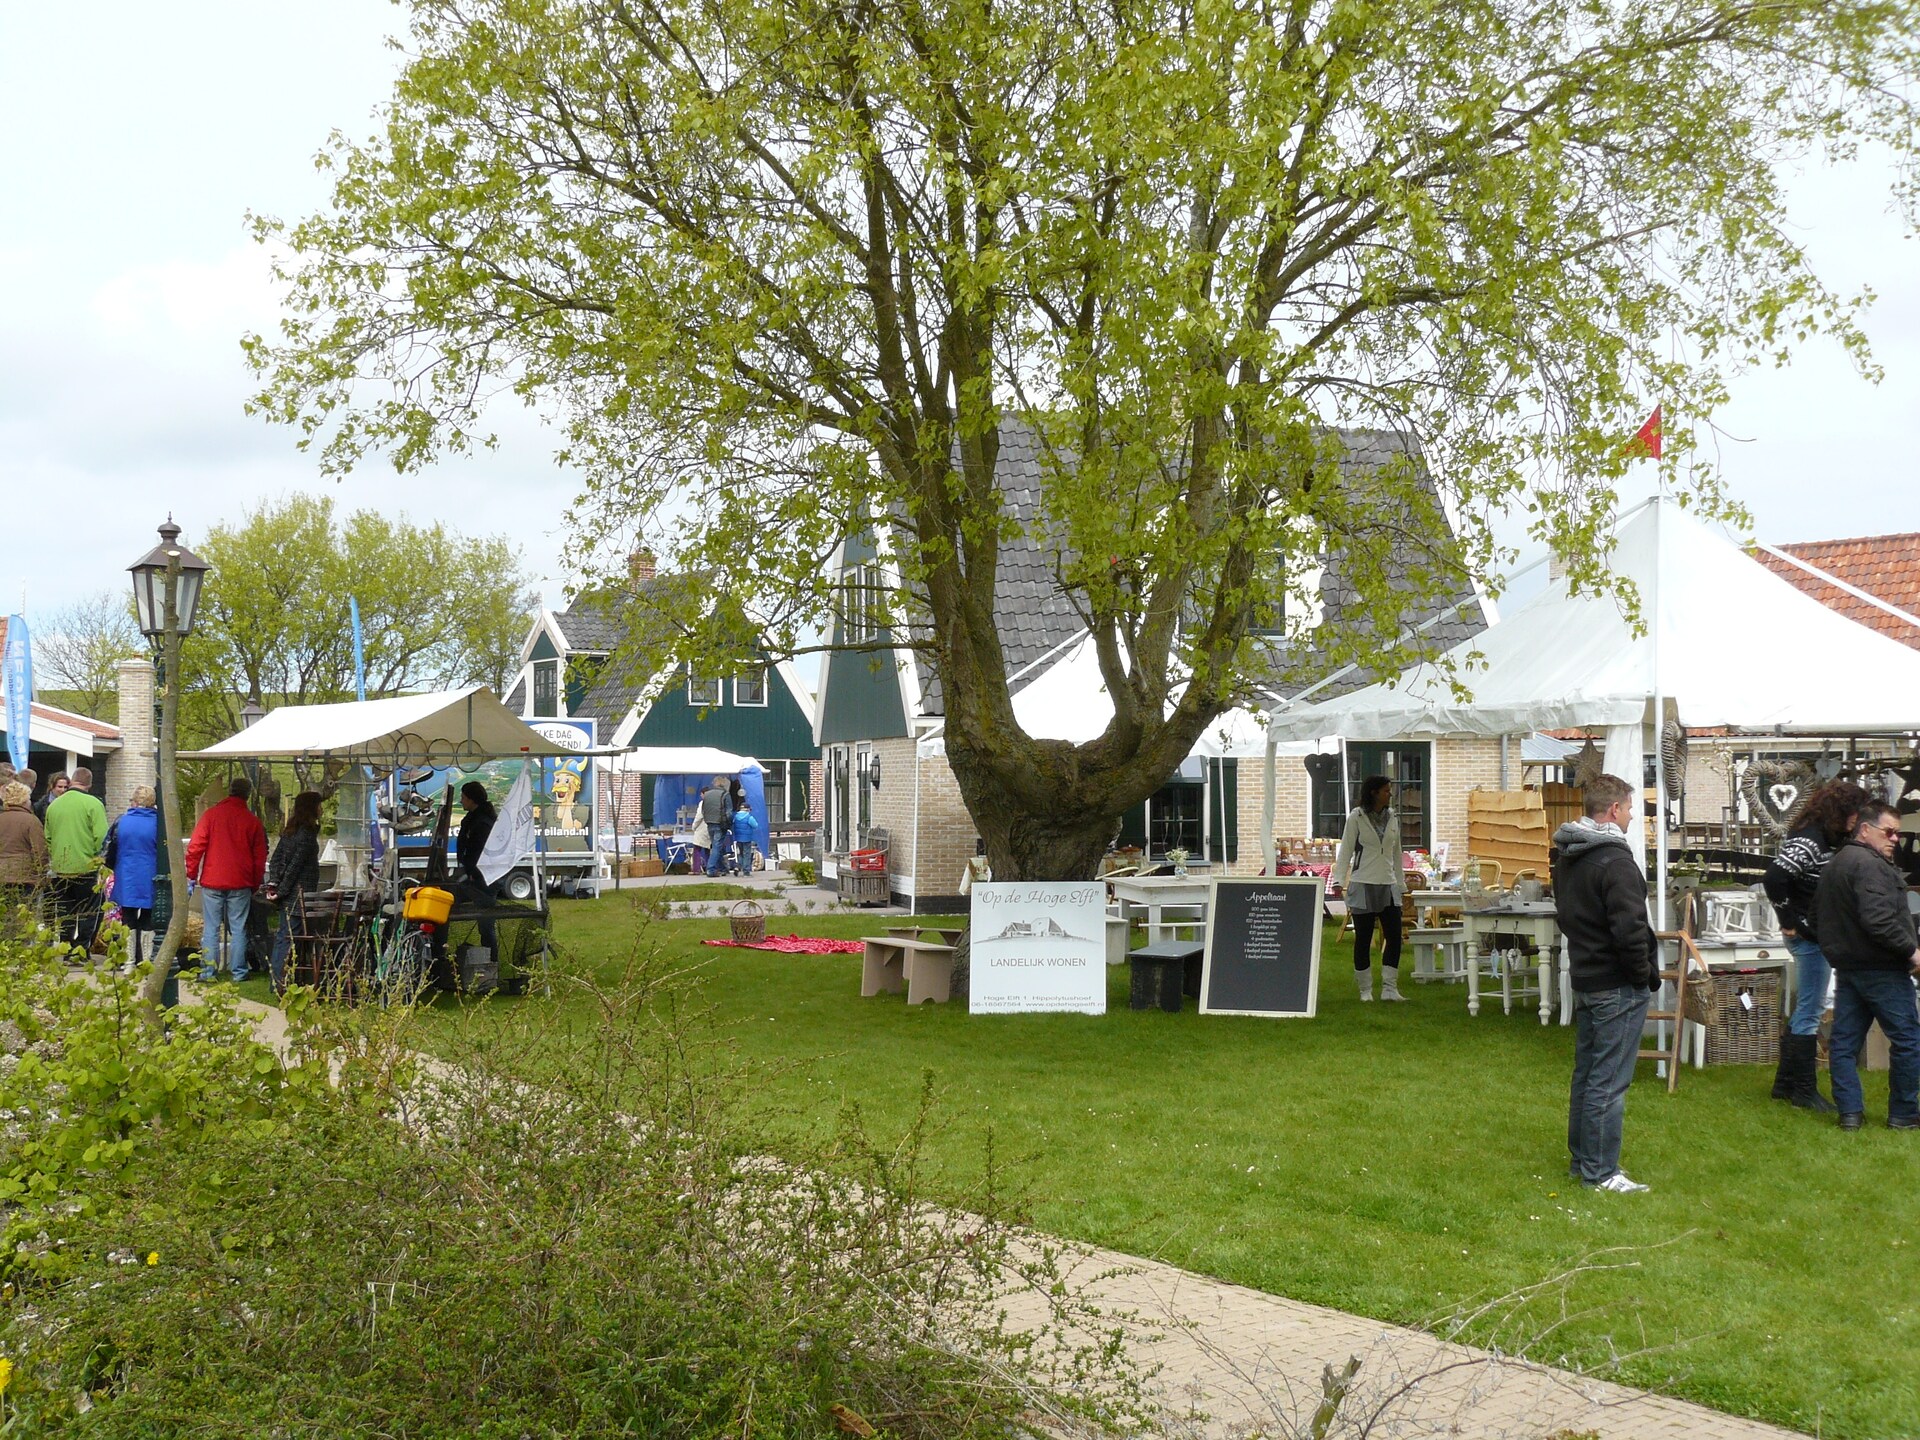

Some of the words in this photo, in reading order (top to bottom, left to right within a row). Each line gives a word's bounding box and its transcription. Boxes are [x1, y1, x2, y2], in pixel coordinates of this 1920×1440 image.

[556, 730, 572, 739] DAG
[1005, 889, 1021, 904] de
[1024, 890, 1067, 908] Hoge
[990, 958, 1044, 967] LANDELIJK
[1046, 958, 1086, 967] WONEN
